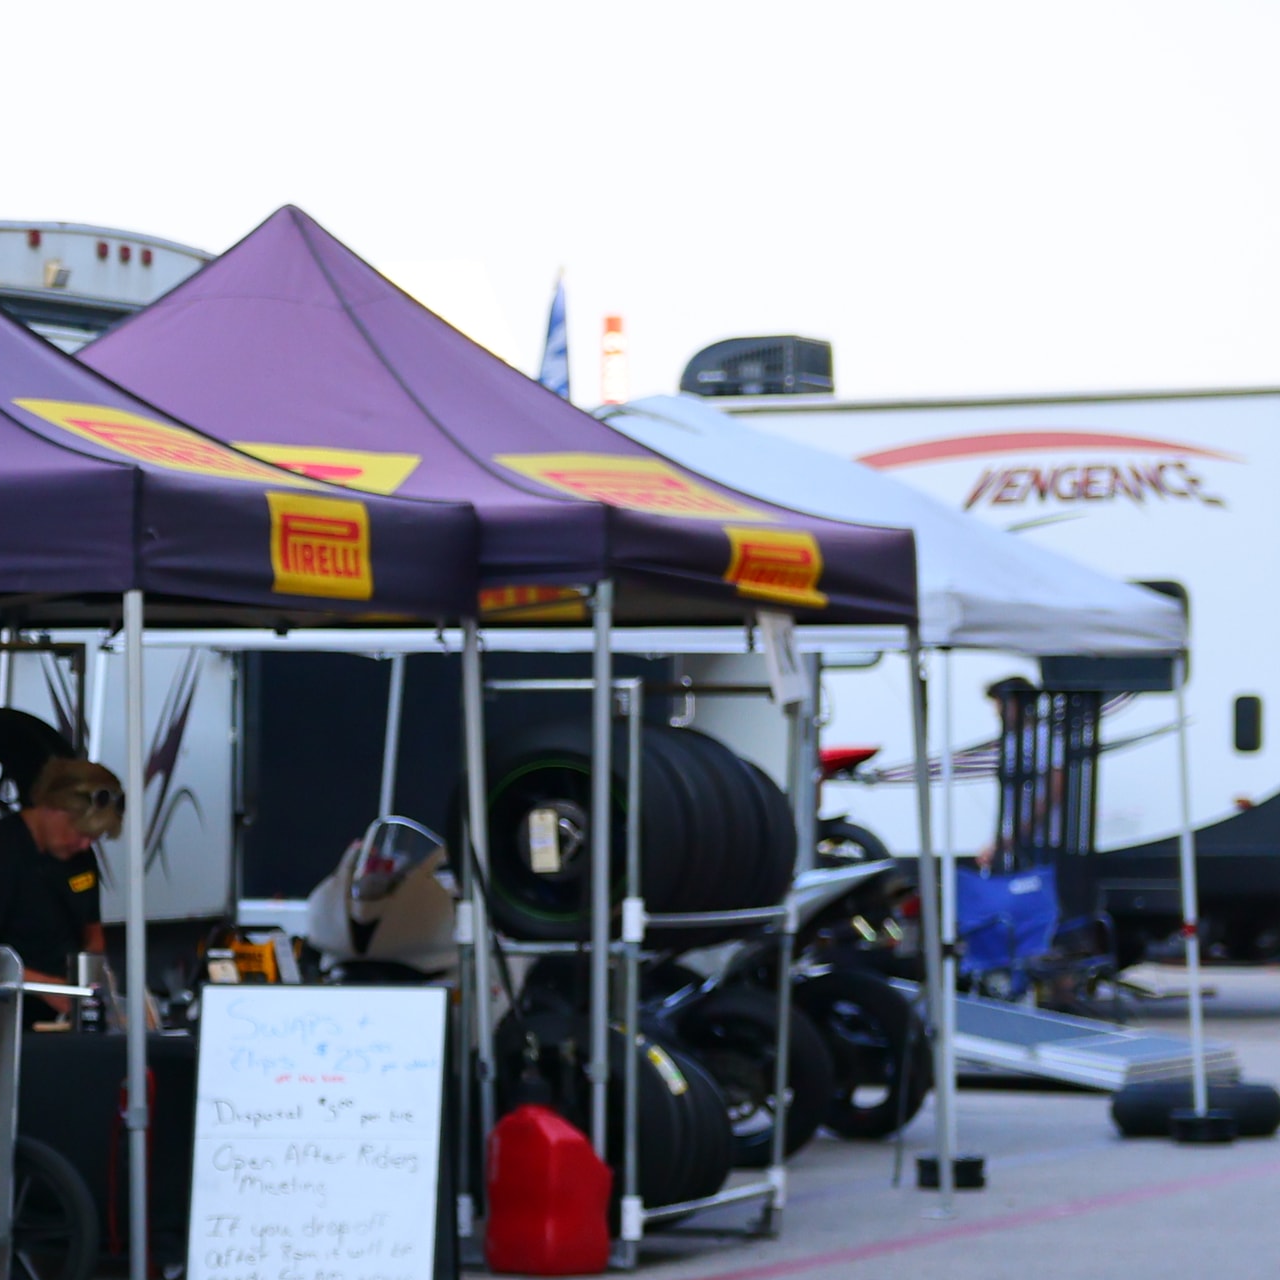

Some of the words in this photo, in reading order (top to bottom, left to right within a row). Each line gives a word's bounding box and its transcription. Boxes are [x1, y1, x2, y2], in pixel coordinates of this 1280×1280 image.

[281, 512, 362, 579] PIRELLI
[214, 1099, 303, 1128] Disposal
[212, 1144, 274, 1184] Open
[238, 1174, 326, 1208] Meeting
